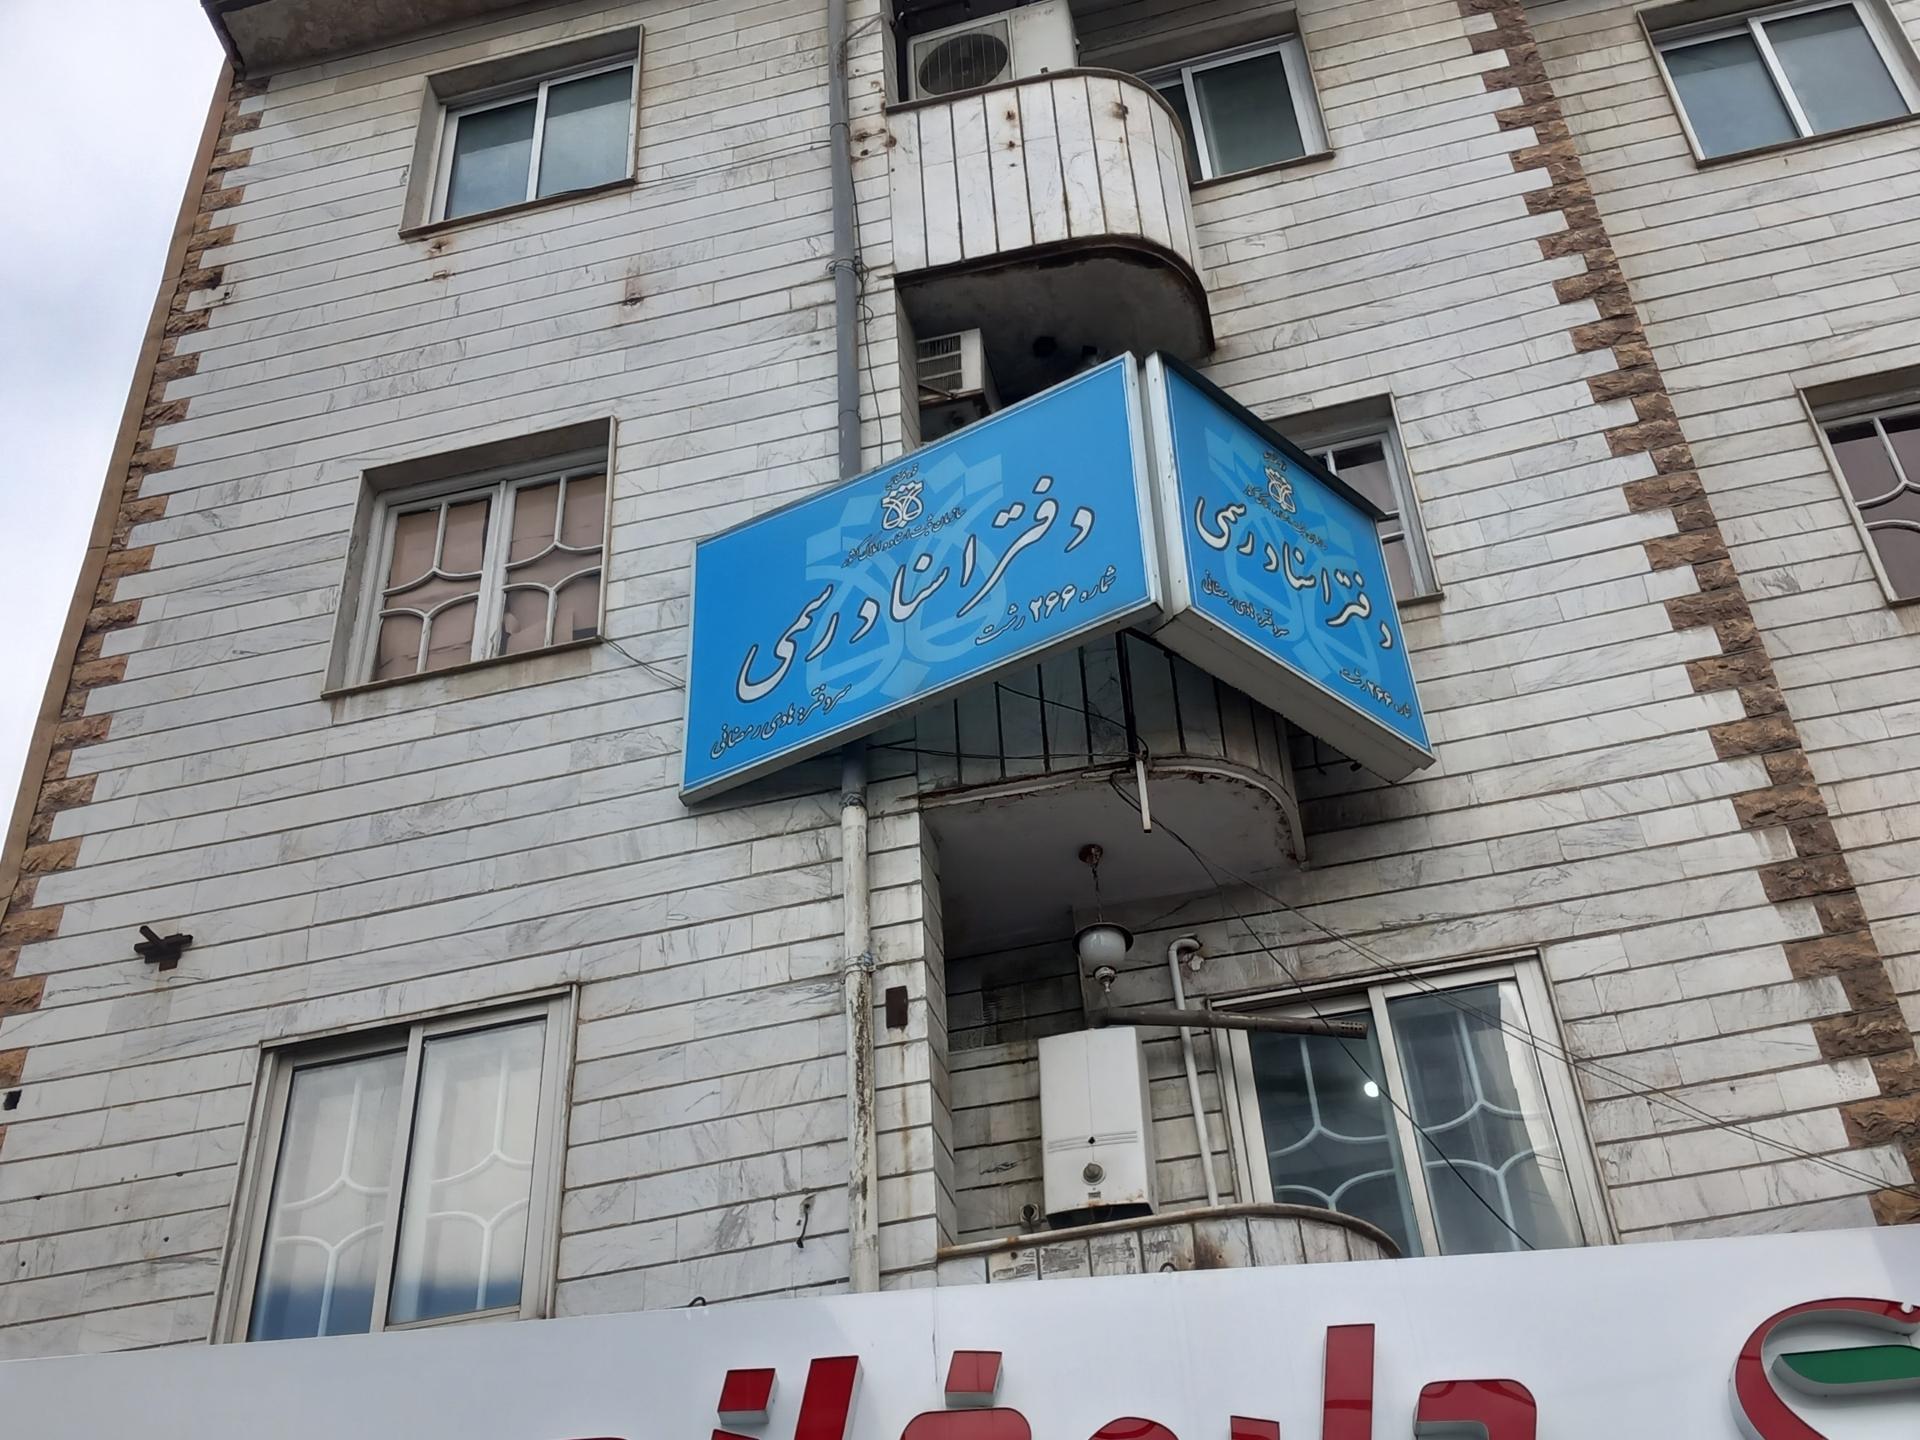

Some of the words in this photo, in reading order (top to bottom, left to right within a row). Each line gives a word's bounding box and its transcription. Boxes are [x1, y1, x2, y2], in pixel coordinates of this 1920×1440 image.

[956, 475, 1096, 618] دفتر
[1193, 496, 1255, 558] رسمی
[850, 533, 977, 644] اسناد
[1078, 564, 1117, 603] شماره
[1263, 540, 1331, 604] اسناد
[974, 603, 1026, 646] رشت
[1028, 583, 1078, 624] ۲۶۶
[1326, 570, 1394, 650] دفتر
[735, 583, 839, 703] رسمی
[709, 723, 763, 760] رمضانی
[761, 702, 796, 740] هادی
